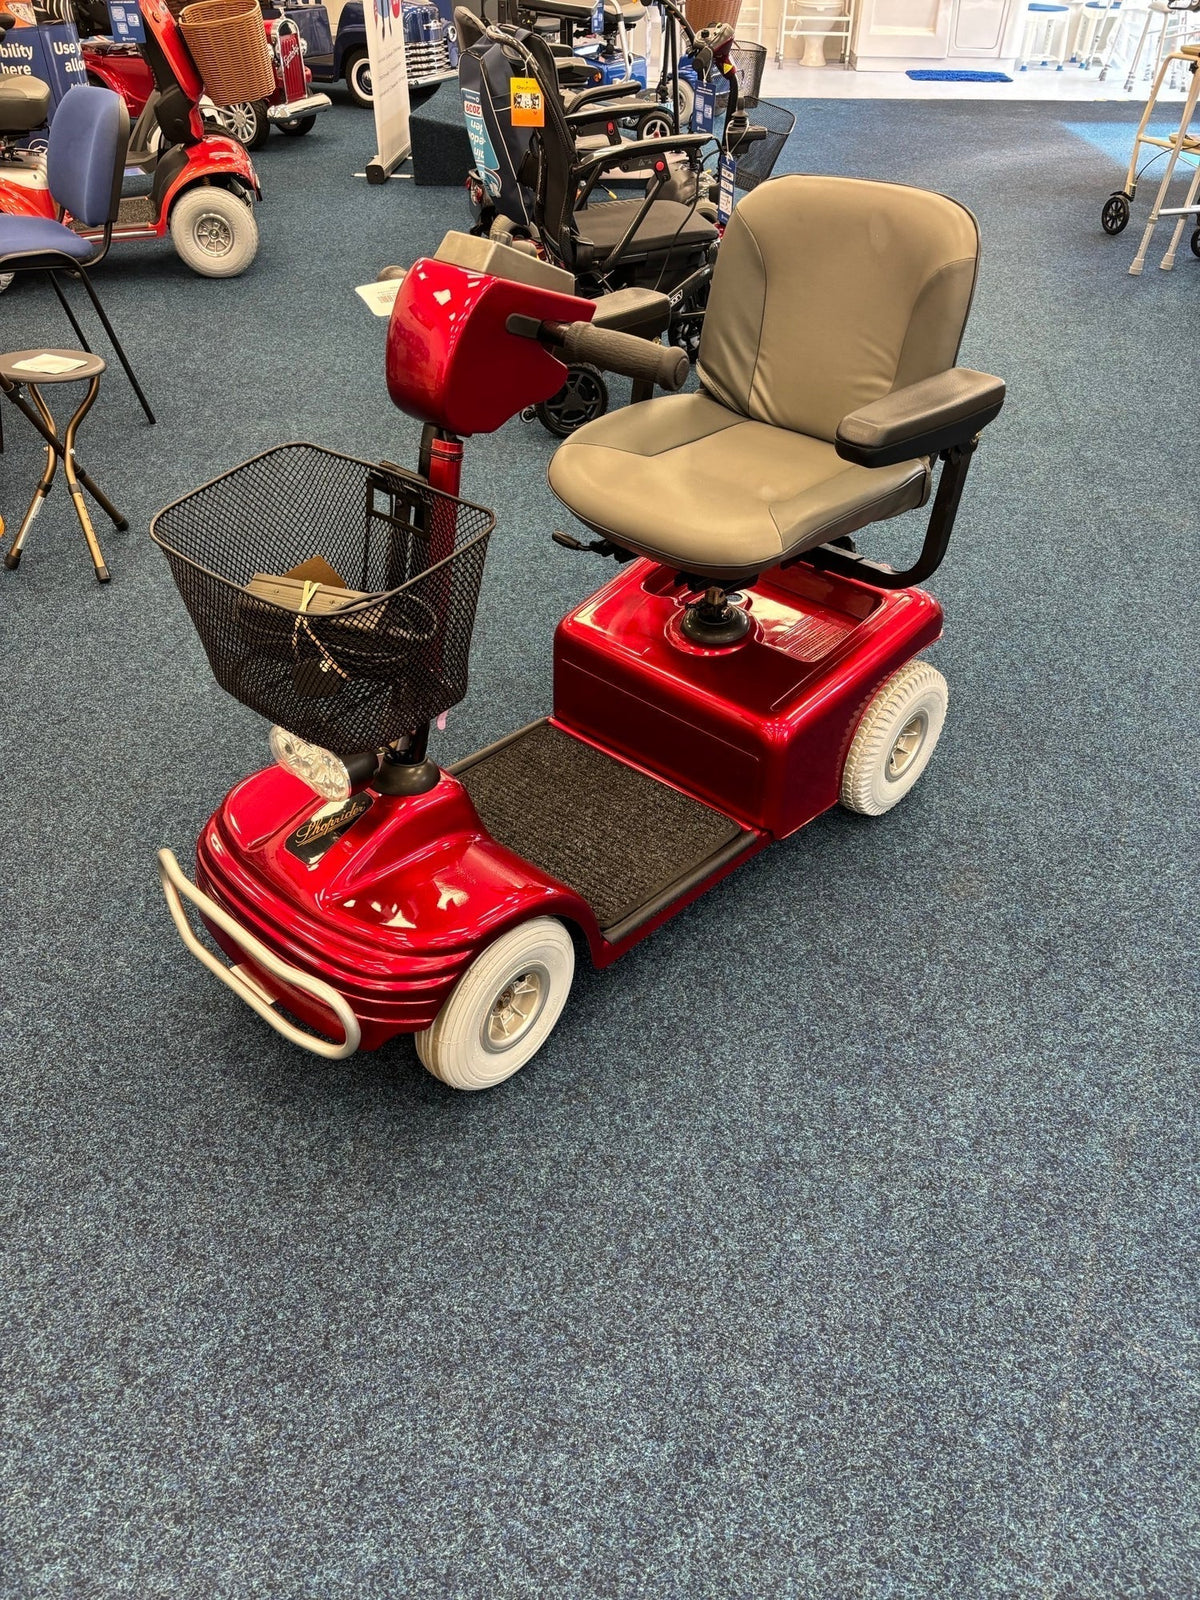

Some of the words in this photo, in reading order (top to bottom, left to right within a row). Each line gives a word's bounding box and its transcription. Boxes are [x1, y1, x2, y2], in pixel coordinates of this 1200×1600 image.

[0, 43, 33, 60] bility
[53, 42, 76, 55] Use
[1, 62, 31, 75] here
[295, 802, 366, 845] Shoprider
